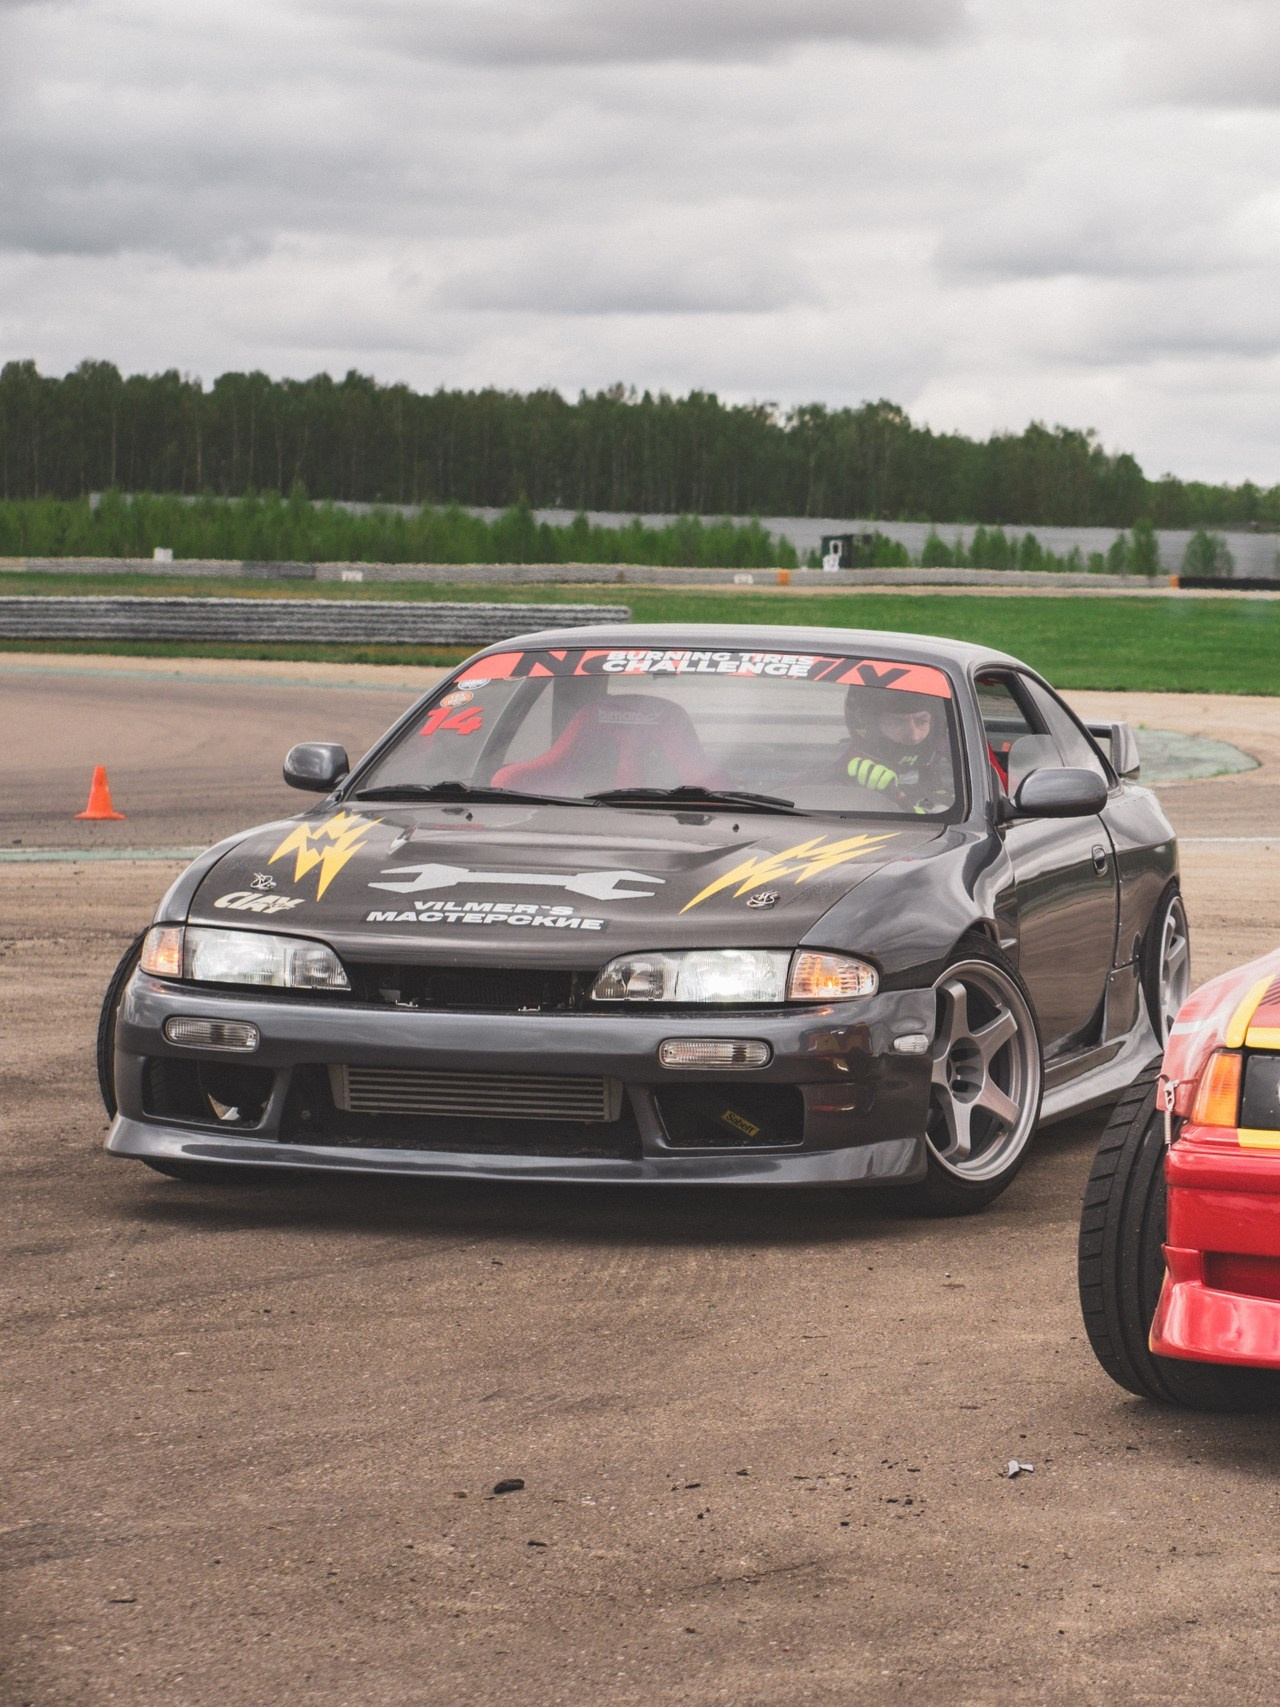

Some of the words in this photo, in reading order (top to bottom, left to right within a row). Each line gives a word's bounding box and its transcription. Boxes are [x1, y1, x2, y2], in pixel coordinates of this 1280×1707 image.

[606, 651, 731, 662] BURNING
[738, 652, 815, 666] TIRES
[602, 659, 811, 677] CHALLENGE
[419, 707, 484, 735] 14
[366, 911, 604, 930] МАСТЕРСКИЕ
